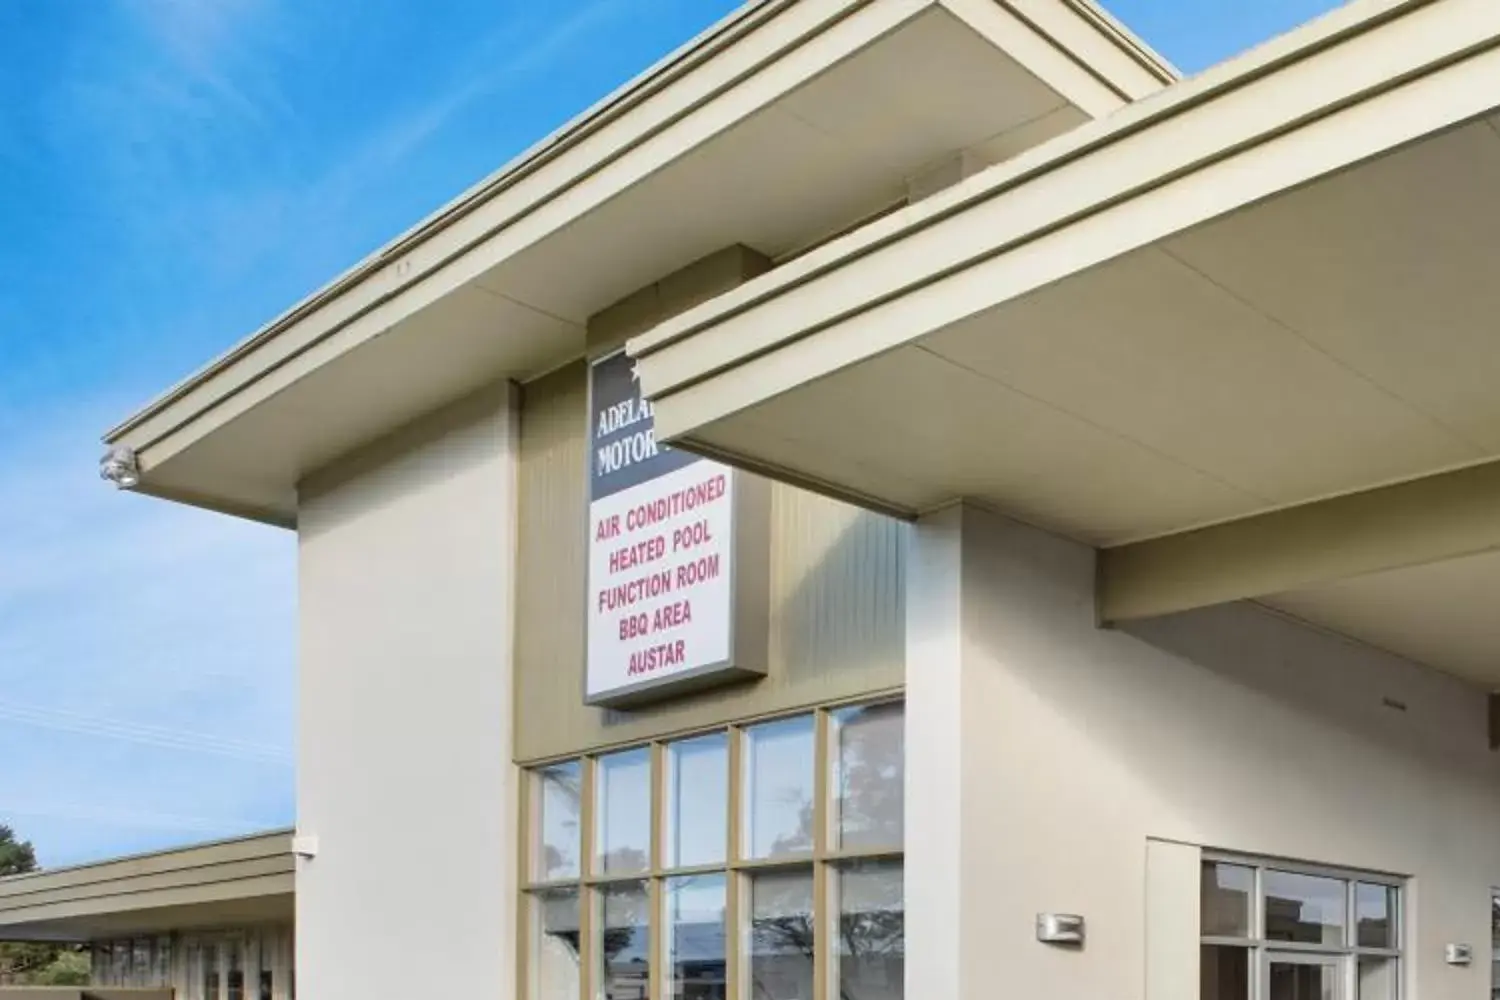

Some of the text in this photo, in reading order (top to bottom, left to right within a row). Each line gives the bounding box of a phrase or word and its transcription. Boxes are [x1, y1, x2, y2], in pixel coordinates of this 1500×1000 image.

[598, 427, 659, 477] MOTOR
[596, 474, 726, 542] AIR CONDITIONED
[609, 519, 712, 574] HEATED POOL
[599, 554, 719, 613] FUNCTION ROOM
[619, 600, 691, 641] BBQ AREA
[628, 639, 685, 676] AUSTAR
